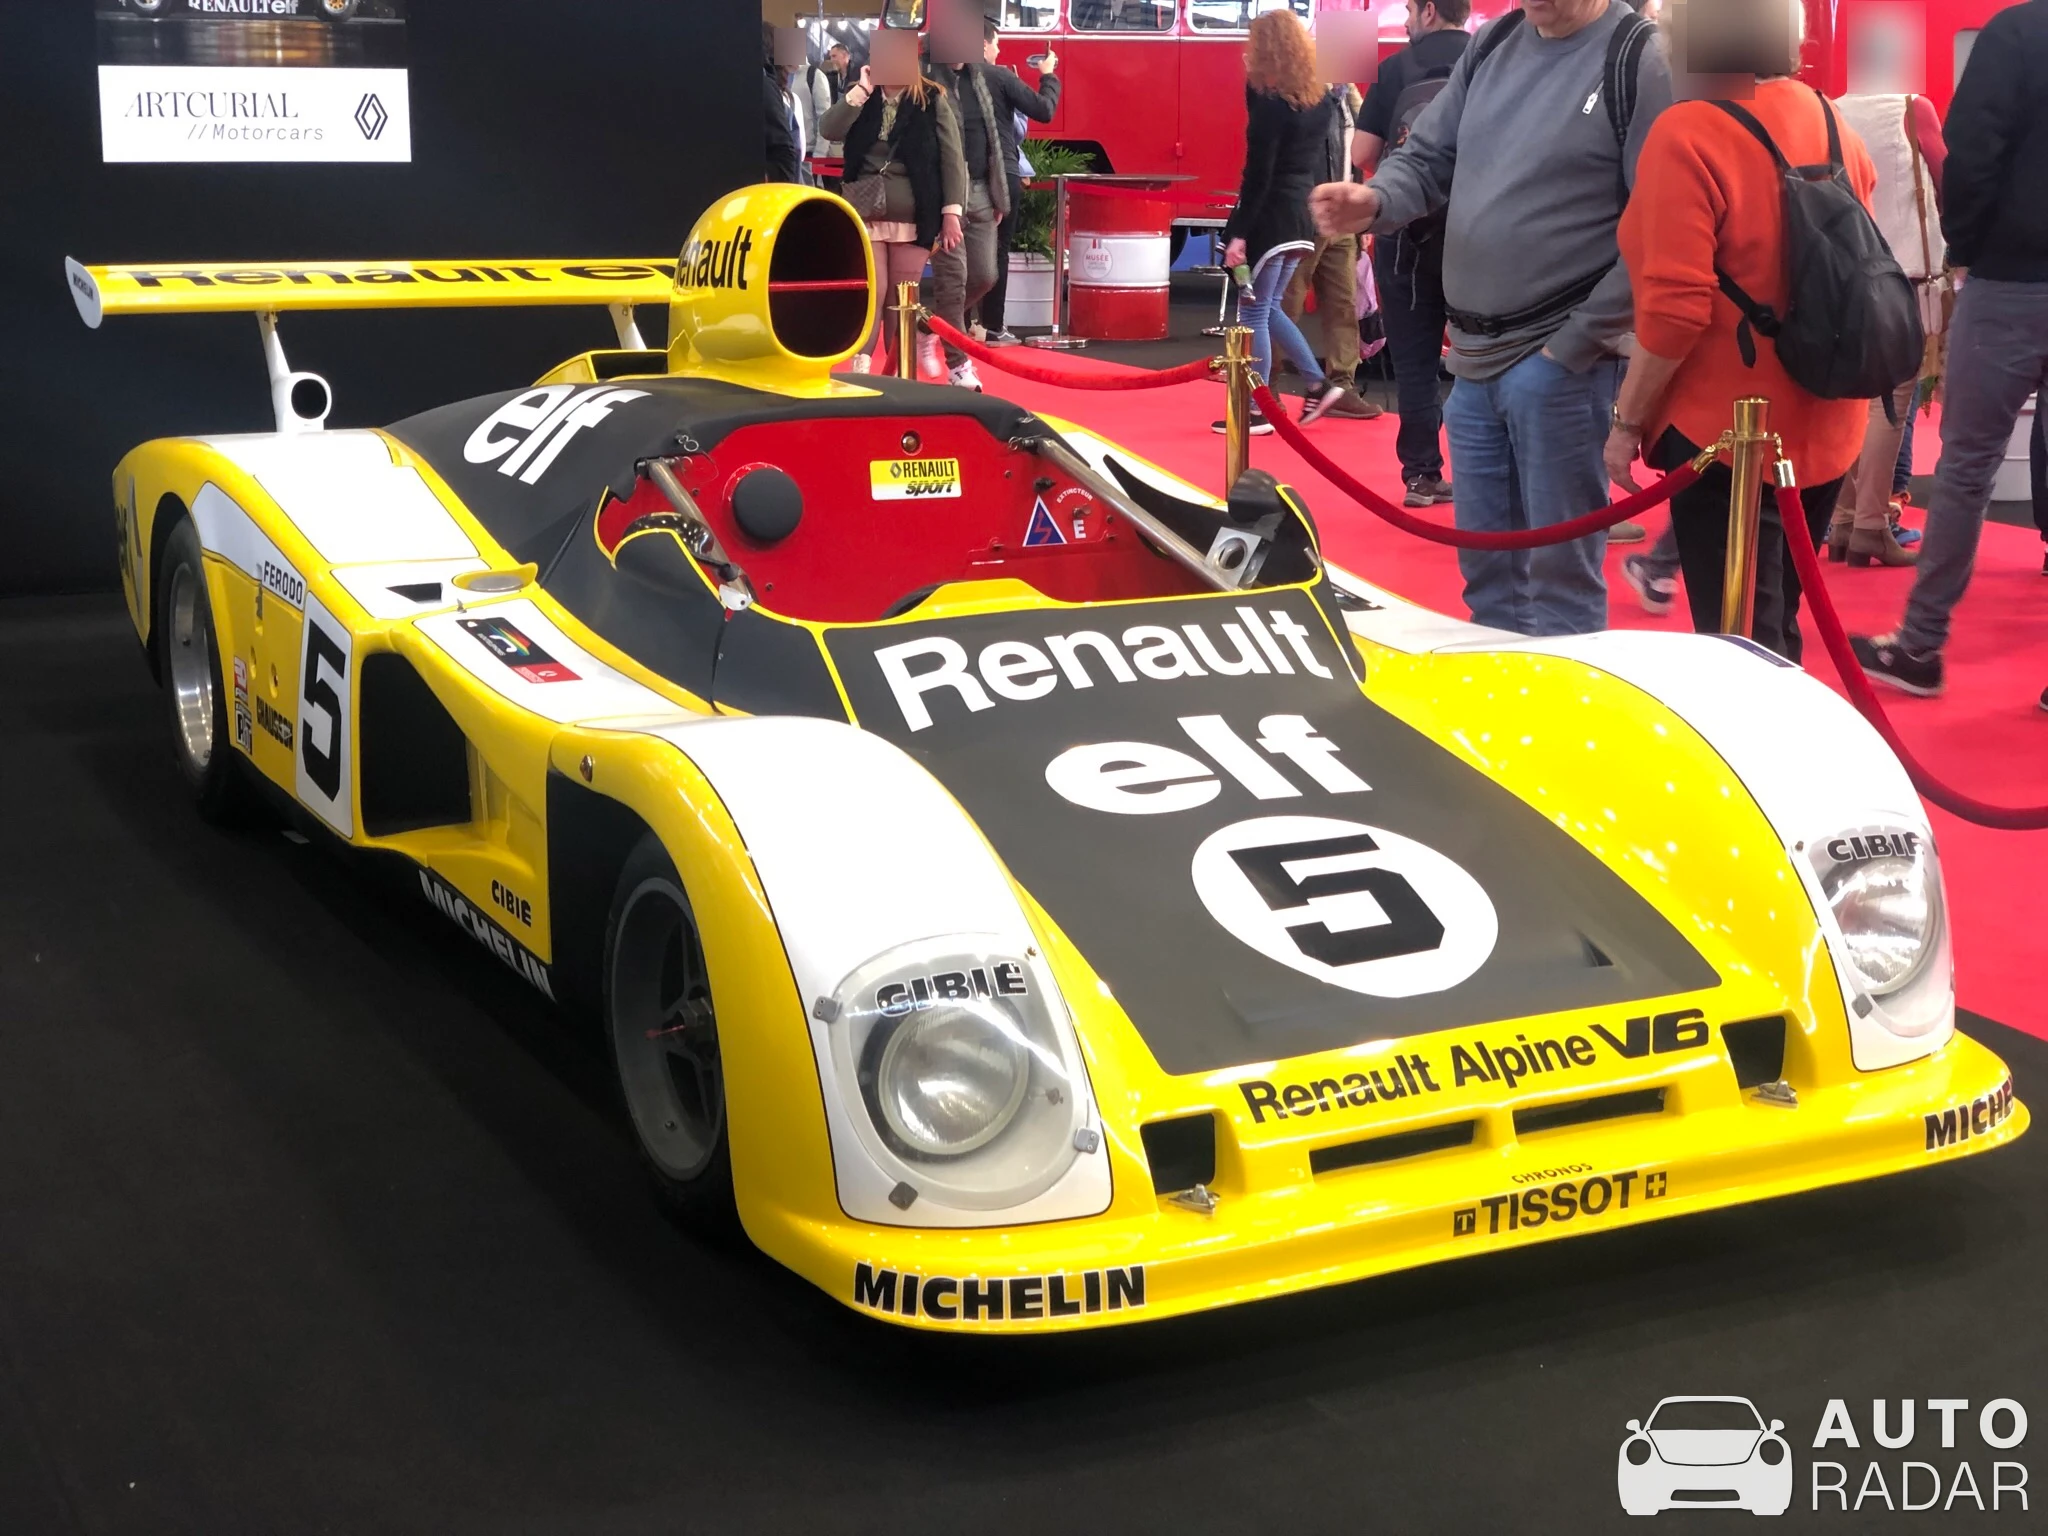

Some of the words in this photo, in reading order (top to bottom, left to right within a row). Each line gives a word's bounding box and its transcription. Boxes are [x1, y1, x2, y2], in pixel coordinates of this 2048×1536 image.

[124, 92, 299, 118] ARTCURIAL
[128, 264, 552, 288] Renault
[463, 384, 653, 485] elf
[903, 460, 955, 478] RENAULT
[905, 478, 955, 496] sport
[1056, 488, 1093, 504] EXTINCTEUR
[1073, 519, 1086, 539] E
[263, 560, 304, 604] FERODO
[873, 606, 1335, 732] Renault
[302, 618, 347, 802] 5
[1045, 714, 1373, 815] elf
[1227, 833, 1444, 968] 5
[419, 869, 558, 1004] MICHELIN
[1239, 1053, 1441, 1124] Renault
[1451, 1033, 1597, 1089] Alpine
[1588, 1008, 1709, 1059] V6
[1480, 1170, 1638, 1234] TISSOT
[1511, 1162, 1594, 1185] CHRONOS
[853, 1262, 1146, 1321] MICHELIN
